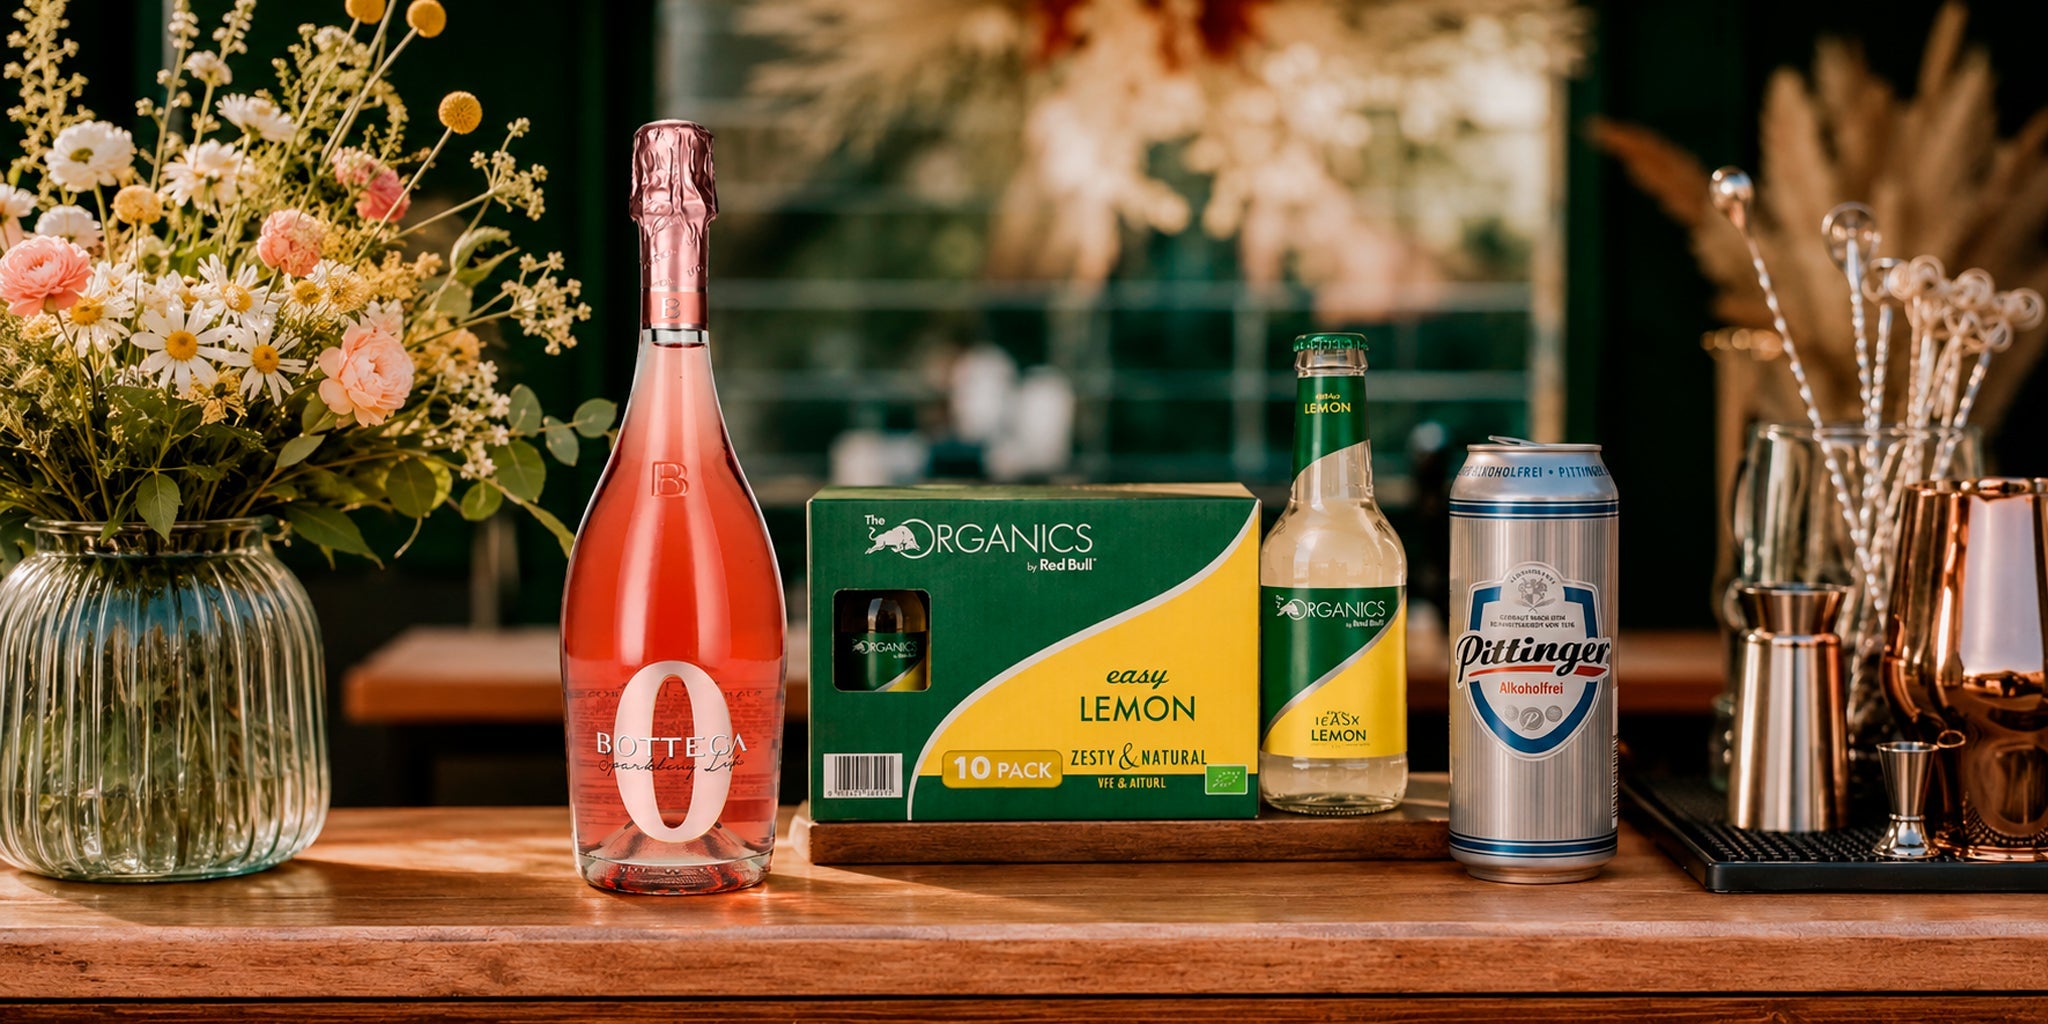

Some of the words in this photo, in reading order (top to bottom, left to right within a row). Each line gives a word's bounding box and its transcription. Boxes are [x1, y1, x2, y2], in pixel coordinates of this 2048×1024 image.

[661, 298, 681, 319] B
[1304, 402, 1351, 414] LEMON
[652, 461, 689, 497] B
[865, 514, 886, 526] The
[899, 518, 1093, 559] ORGANICS
[1027, 562, 1038, 573] by
[1040, 558, 1065, 571] Red
[1068, 558, 1093, 571] Bull
[1287, 599, 1386, 620] ORGANICS
[1456, 635, 1610, 683] Pittinger
[1106, 669, 1170, 689] easy
[1499, 682, 1564, 695] Alkoholfrei
[1080, 696, 1195, 722] LEMON
[596, 731, 747, 758] BOTTEGA
[1311, 729, 1366, 741] LEMON
[1071, 750, 1115, 766] ZESTY
[1118, 742, 1139, 770] &
[1142, 749, 1207, 766] NATURAL
[954, 755, 991, 780] 10
[998, 761, 1052, 779] PACK
